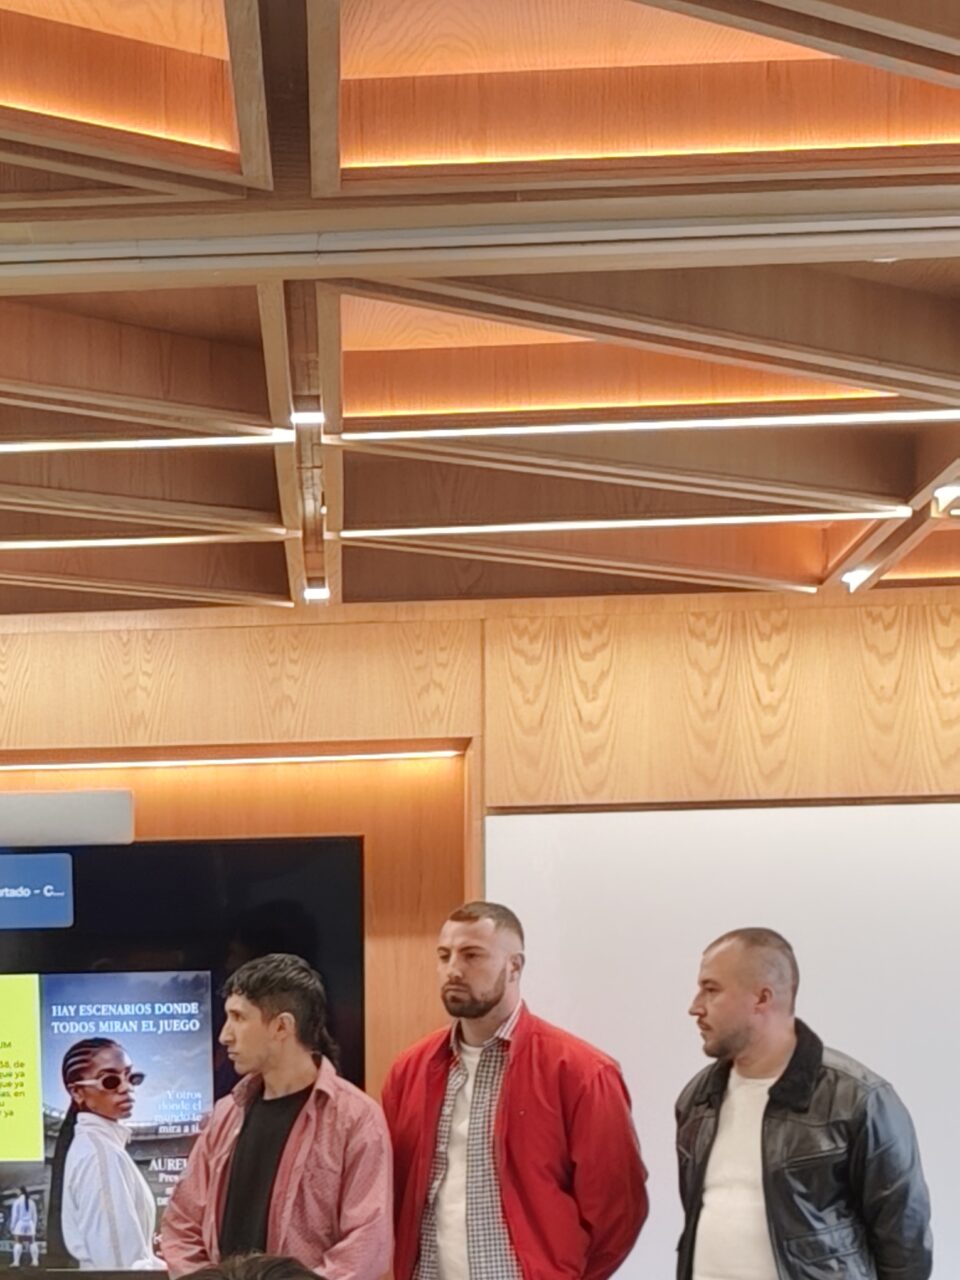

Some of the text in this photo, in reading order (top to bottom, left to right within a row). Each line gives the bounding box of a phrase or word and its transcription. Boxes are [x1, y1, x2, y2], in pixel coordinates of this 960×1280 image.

[51, 1002, 199, 1017] HAY ESCENARIOS DONDE
[51, 1019, 200, 1034] TODOS MIRAN EL JUEGO
[176, 1090, 202, 1099] otros
[158, 1100, 202, 1111] donde el
[4, 1110, 14, 1118] ya
[158, 1124, 182, 1134] mira
[148, 1158, 187, 1171] AURE
